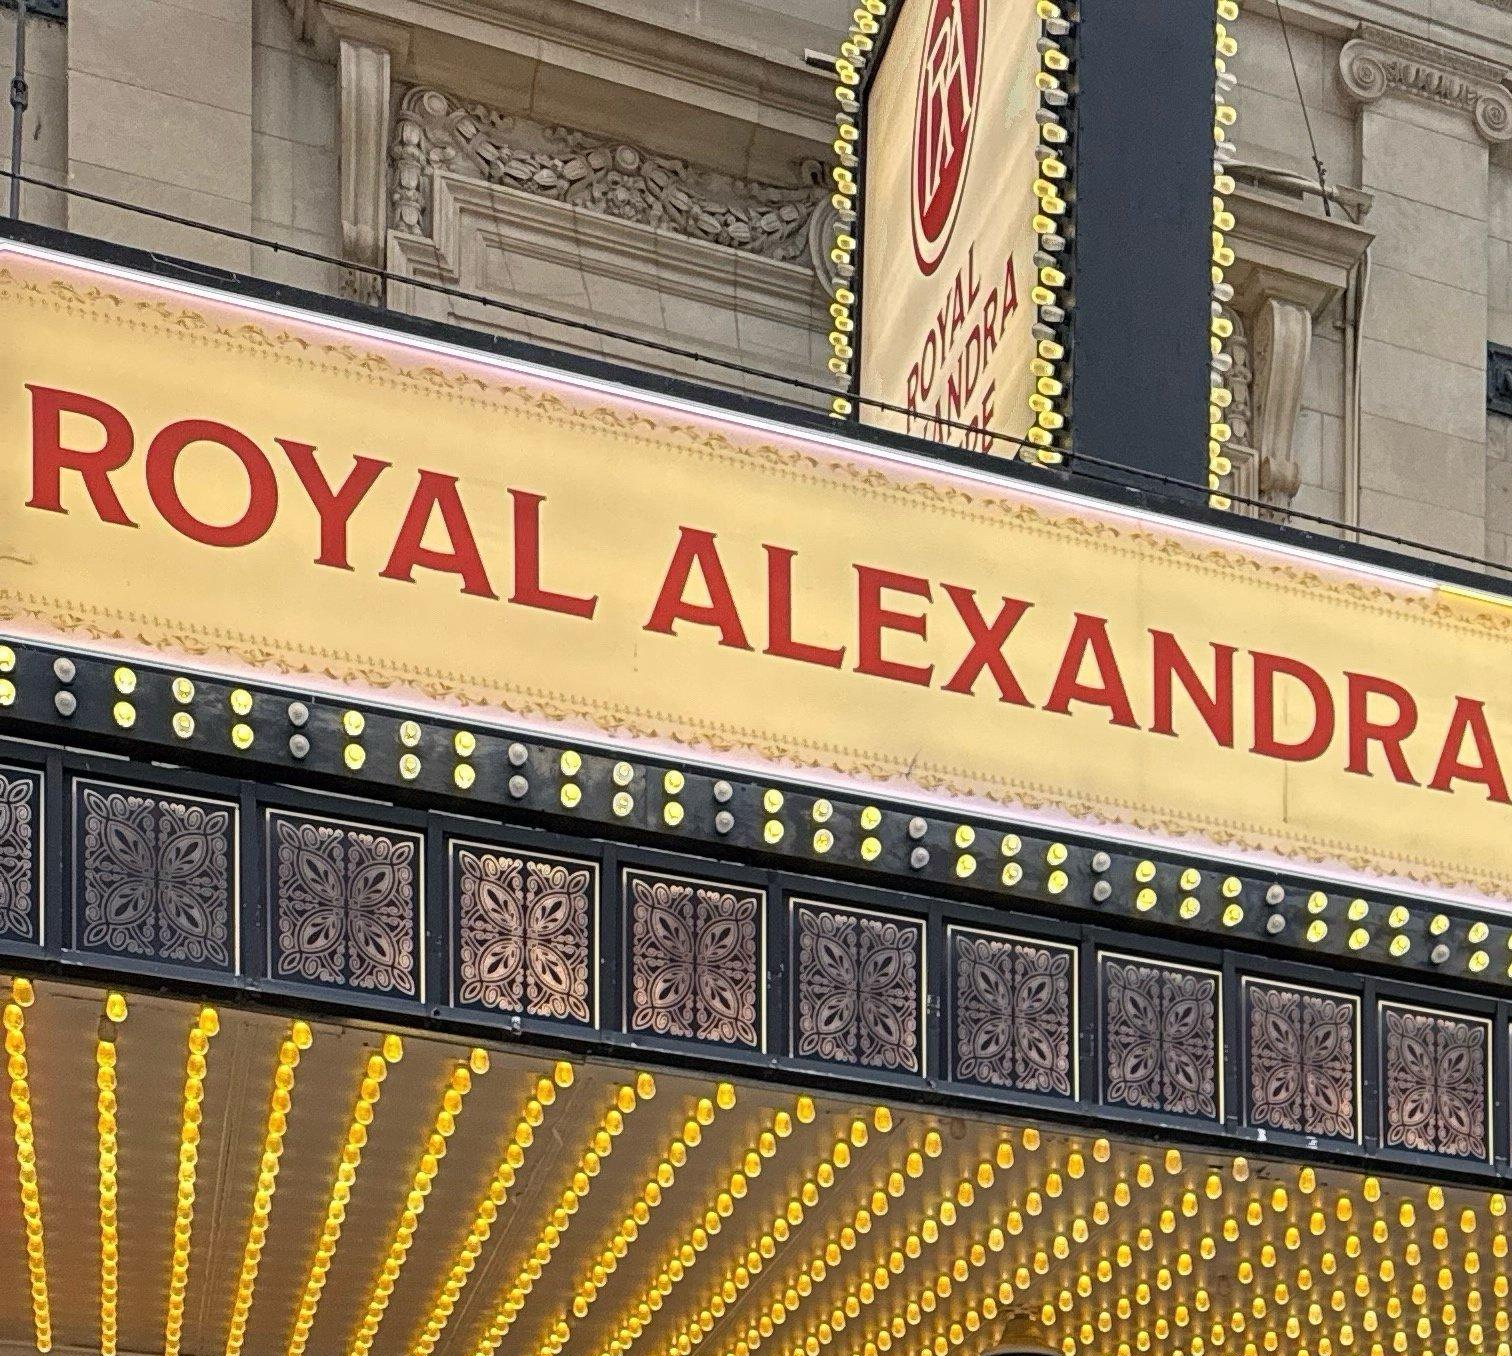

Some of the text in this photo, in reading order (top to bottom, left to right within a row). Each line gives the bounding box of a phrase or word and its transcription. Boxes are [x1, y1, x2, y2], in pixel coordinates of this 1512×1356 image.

[907, 240, 981, 434] ROYAL
[923, 251, 1018, 443] ANDRA
[25, 383, 599, 620] ROYAL
[642, 525, 1512, 806] ALEXANDRA
